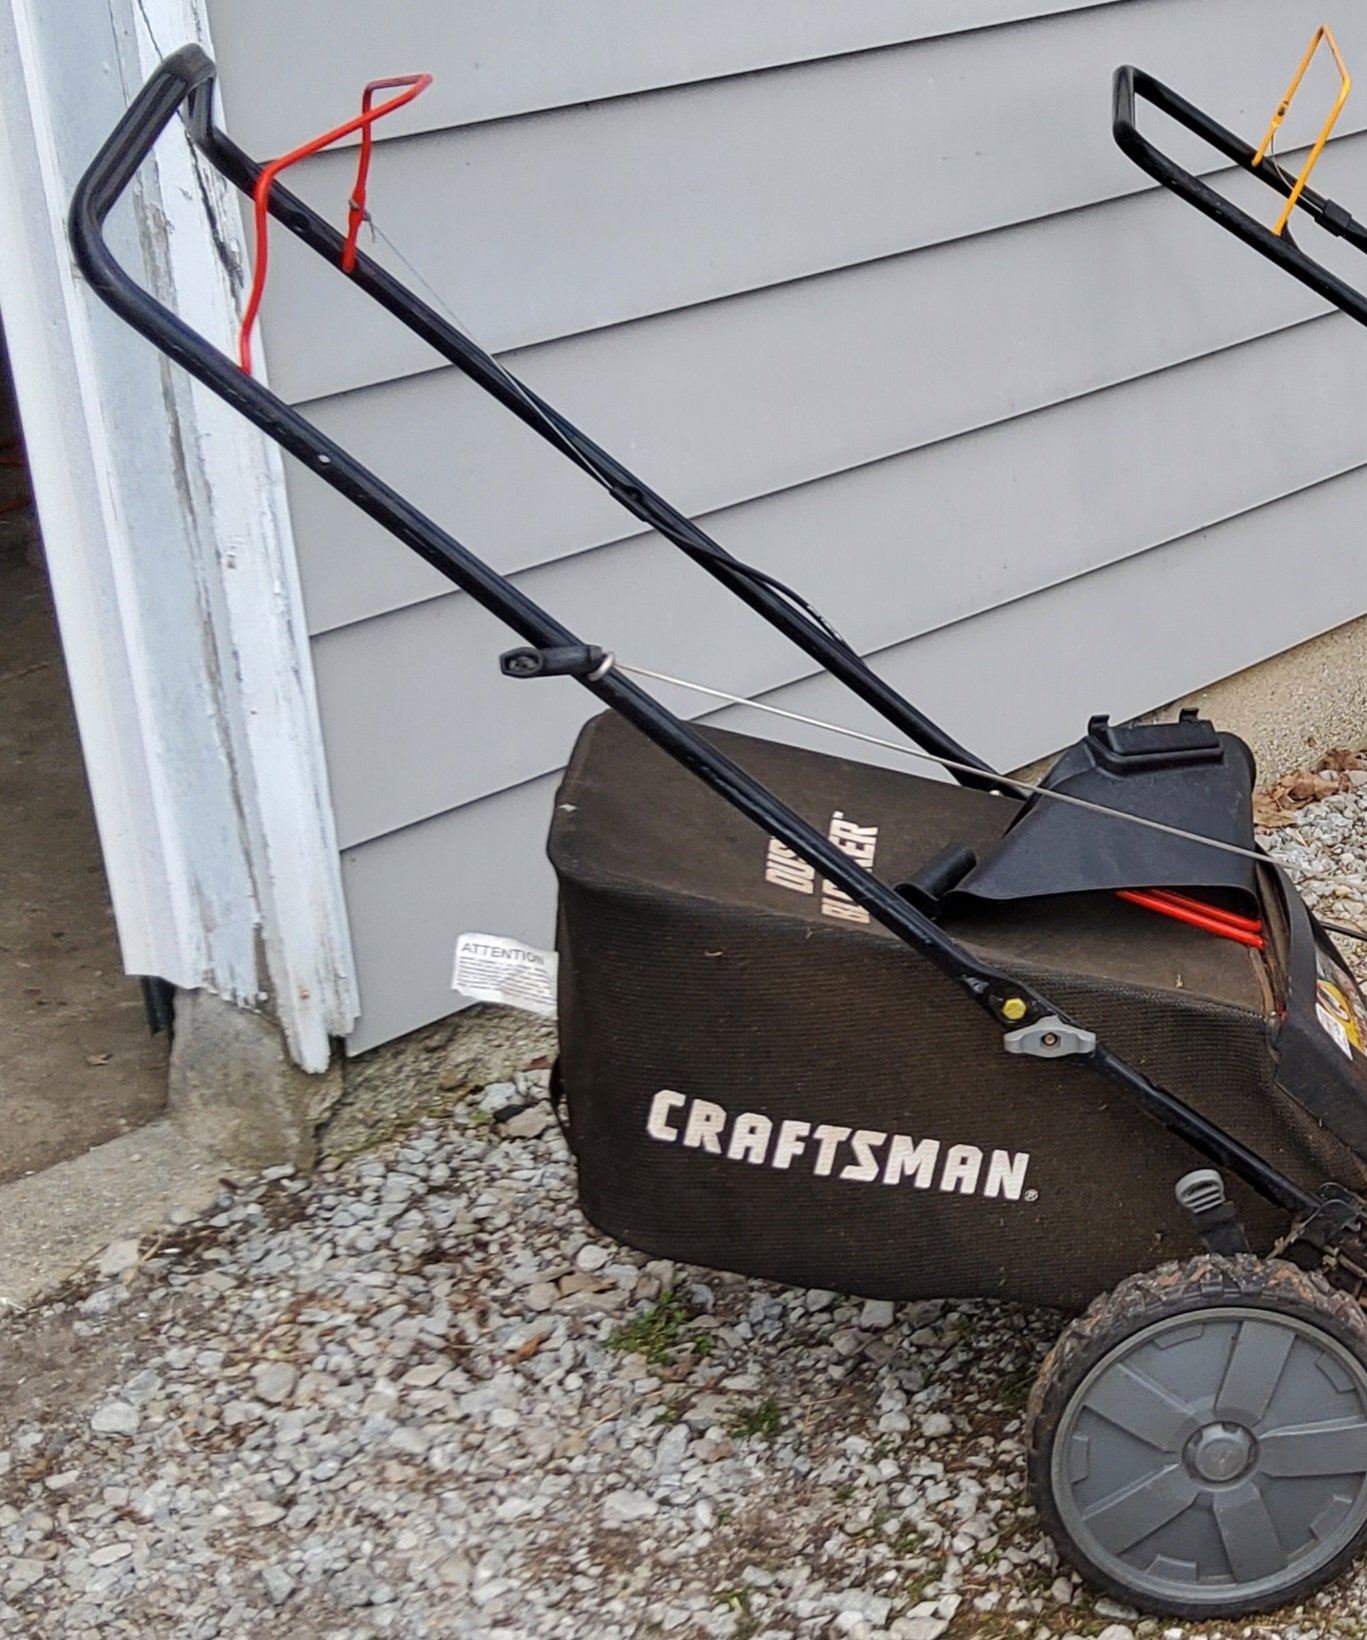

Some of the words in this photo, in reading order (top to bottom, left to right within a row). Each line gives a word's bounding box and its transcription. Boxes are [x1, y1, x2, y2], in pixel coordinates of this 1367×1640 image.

[765, 835, 815, 894] DUS
[462, 943, 544, 965] ATTENTION
[646, 1089, 1030, 1200] CRAFTSMAN
